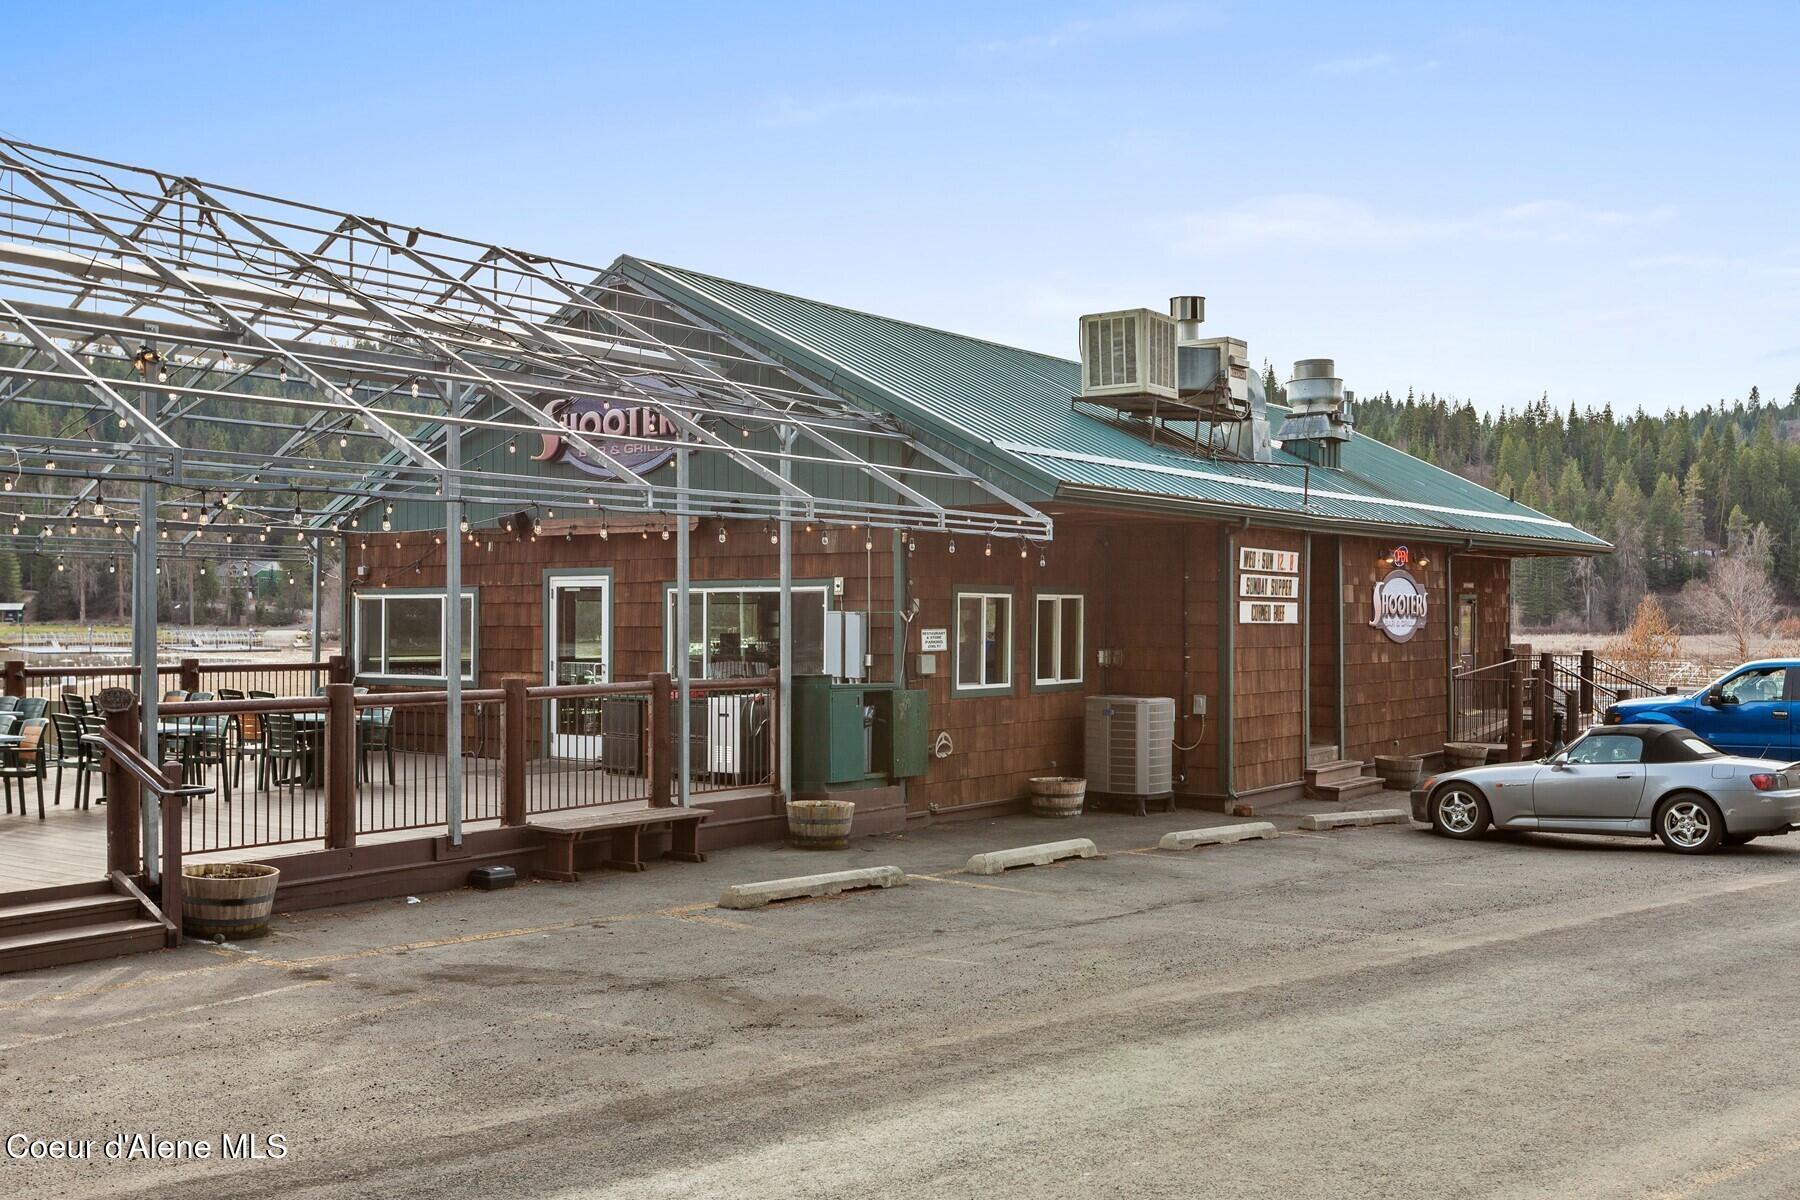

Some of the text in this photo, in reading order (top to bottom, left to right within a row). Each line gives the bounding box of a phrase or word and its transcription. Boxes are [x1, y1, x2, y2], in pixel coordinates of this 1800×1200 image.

[531, 399, 693, 461] SHOOTER
[579, 443, 663, 457] BR & GRILL
[1243, 550, 1256, 569] WED
[1262, 552, 1273, 570] SUN
[1394, 549, 1408, 563] OPEN
[1246, 577, 1292, 596] SUNDAY SUPPER
[1369, 581, 1428, 626] SHOOTERS
